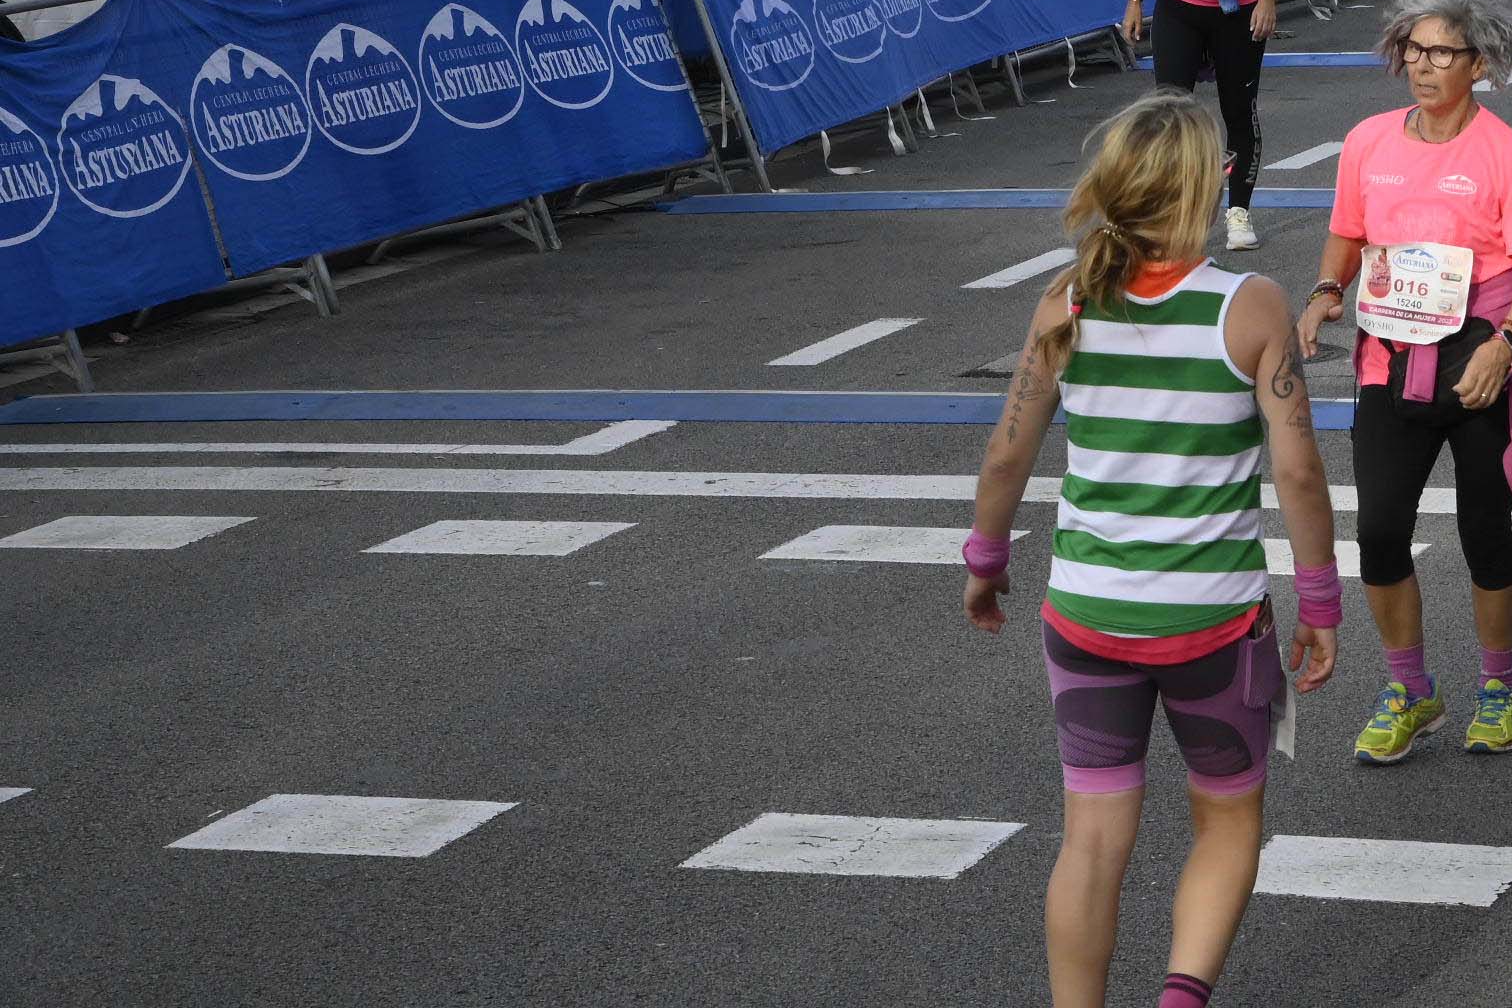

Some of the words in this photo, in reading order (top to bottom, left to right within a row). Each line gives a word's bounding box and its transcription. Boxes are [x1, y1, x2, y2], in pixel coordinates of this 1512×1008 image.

[523, 38, 610, 84] ASTURIANA
[617, 24, 679, 68] ASTUR
[429, 55, 521, 102] ASTURIANA
[316, 78, 417, 129] ASTURIANA
[202, 102, 307, 154] ASTURIANA
[0, 160, 53, 204] RIANA
[70, 129, 183, 191] ASTURIANA
[1394, 278, 1429, 296] 016
[1396, 298, 1422, 309] 15240
[1364, 318, 1394, 332] OYSHO
[1414, 313, 1436, 322] MUJER
